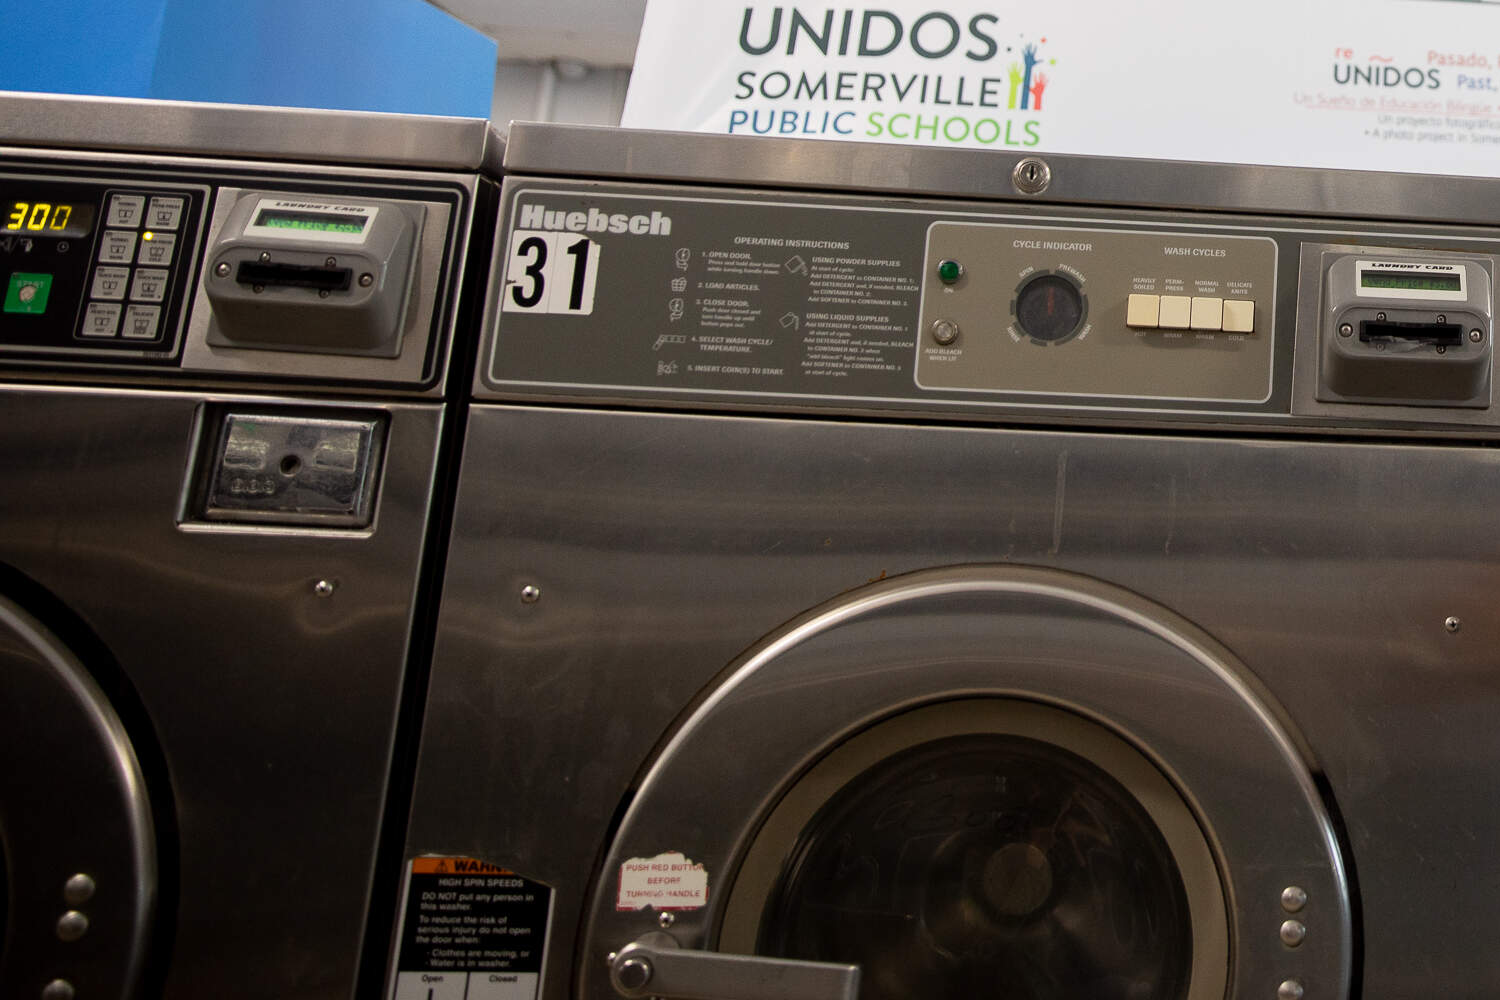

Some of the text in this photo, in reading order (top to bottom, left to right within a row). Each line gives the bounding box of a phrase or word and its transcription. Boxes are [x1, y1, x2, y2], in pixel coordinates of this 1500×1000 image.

[739, 7, 998, 61] UNIDOS
[1428, 50, 1492, 70] Pasado,
[1334, 64, 1440, 89] UNIDOS
[1458, 74, 1498, 91] Past,
[735, 71, 1000, 108] SOMERVILLE
[728, 110, 1040, 146] PUBLIC SCHOOLS
[1459, 133, 1468, 141] in
[8, 202, 72, 231] 300
[520, 205, 672, 236] Huebsch
[734, 237, 850, 249] OPERATING INSTRUCTIONS
[1013, 240, 1092, 251] CYCLE INDICATOR
[1193, 248, 1226, 257] CYCLES
[512, 237, 590, 310] 31
